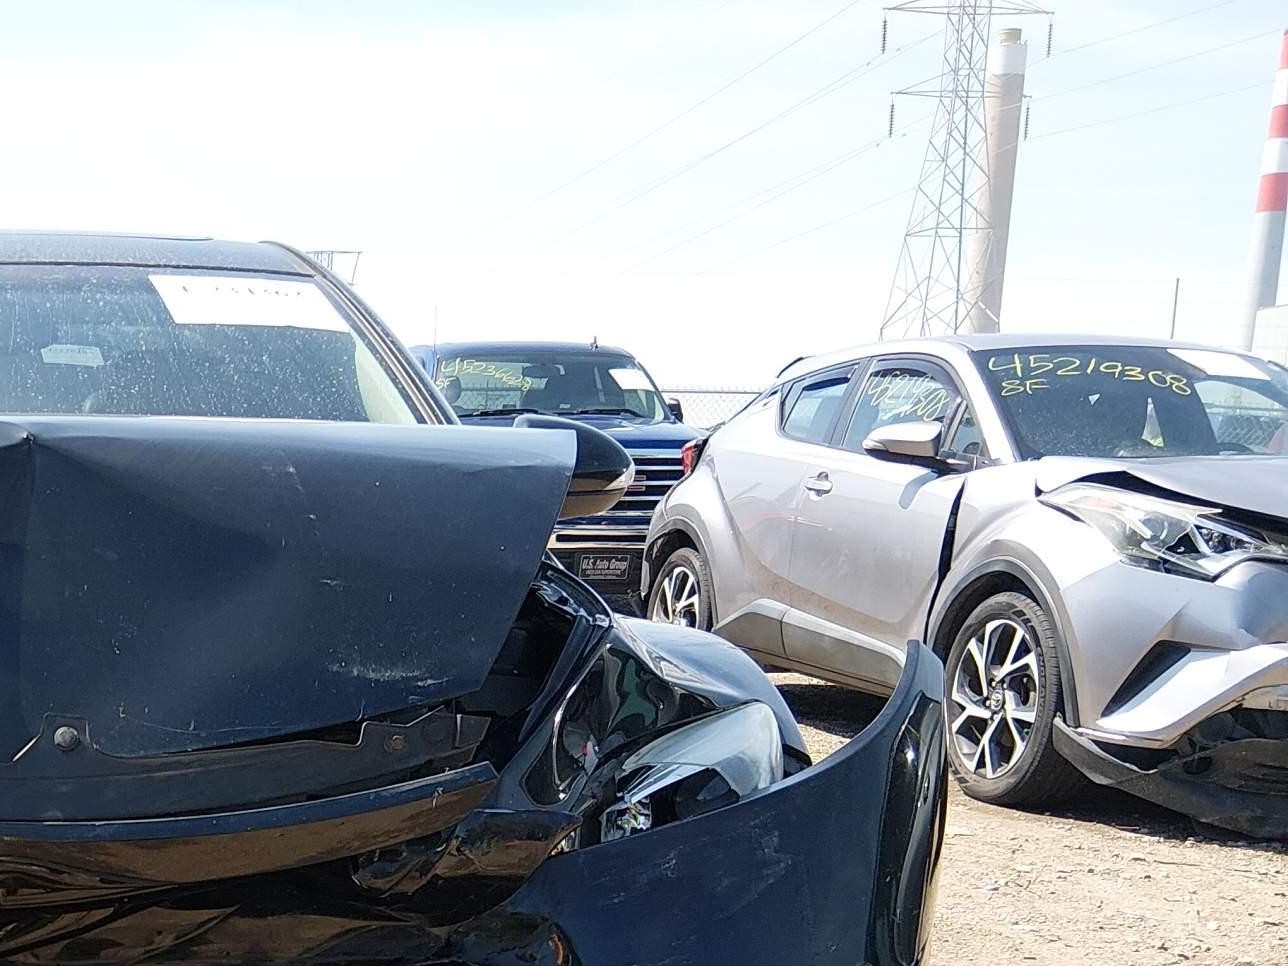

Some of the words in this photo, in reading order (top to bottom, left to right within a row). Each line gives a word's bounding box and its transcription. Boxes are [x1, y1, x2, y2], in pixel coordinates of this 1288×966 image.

[988, 353, 1192, 396] 45219308
[595, 559, 608, 569] Auto
[610, 558, 627, 571] Group
